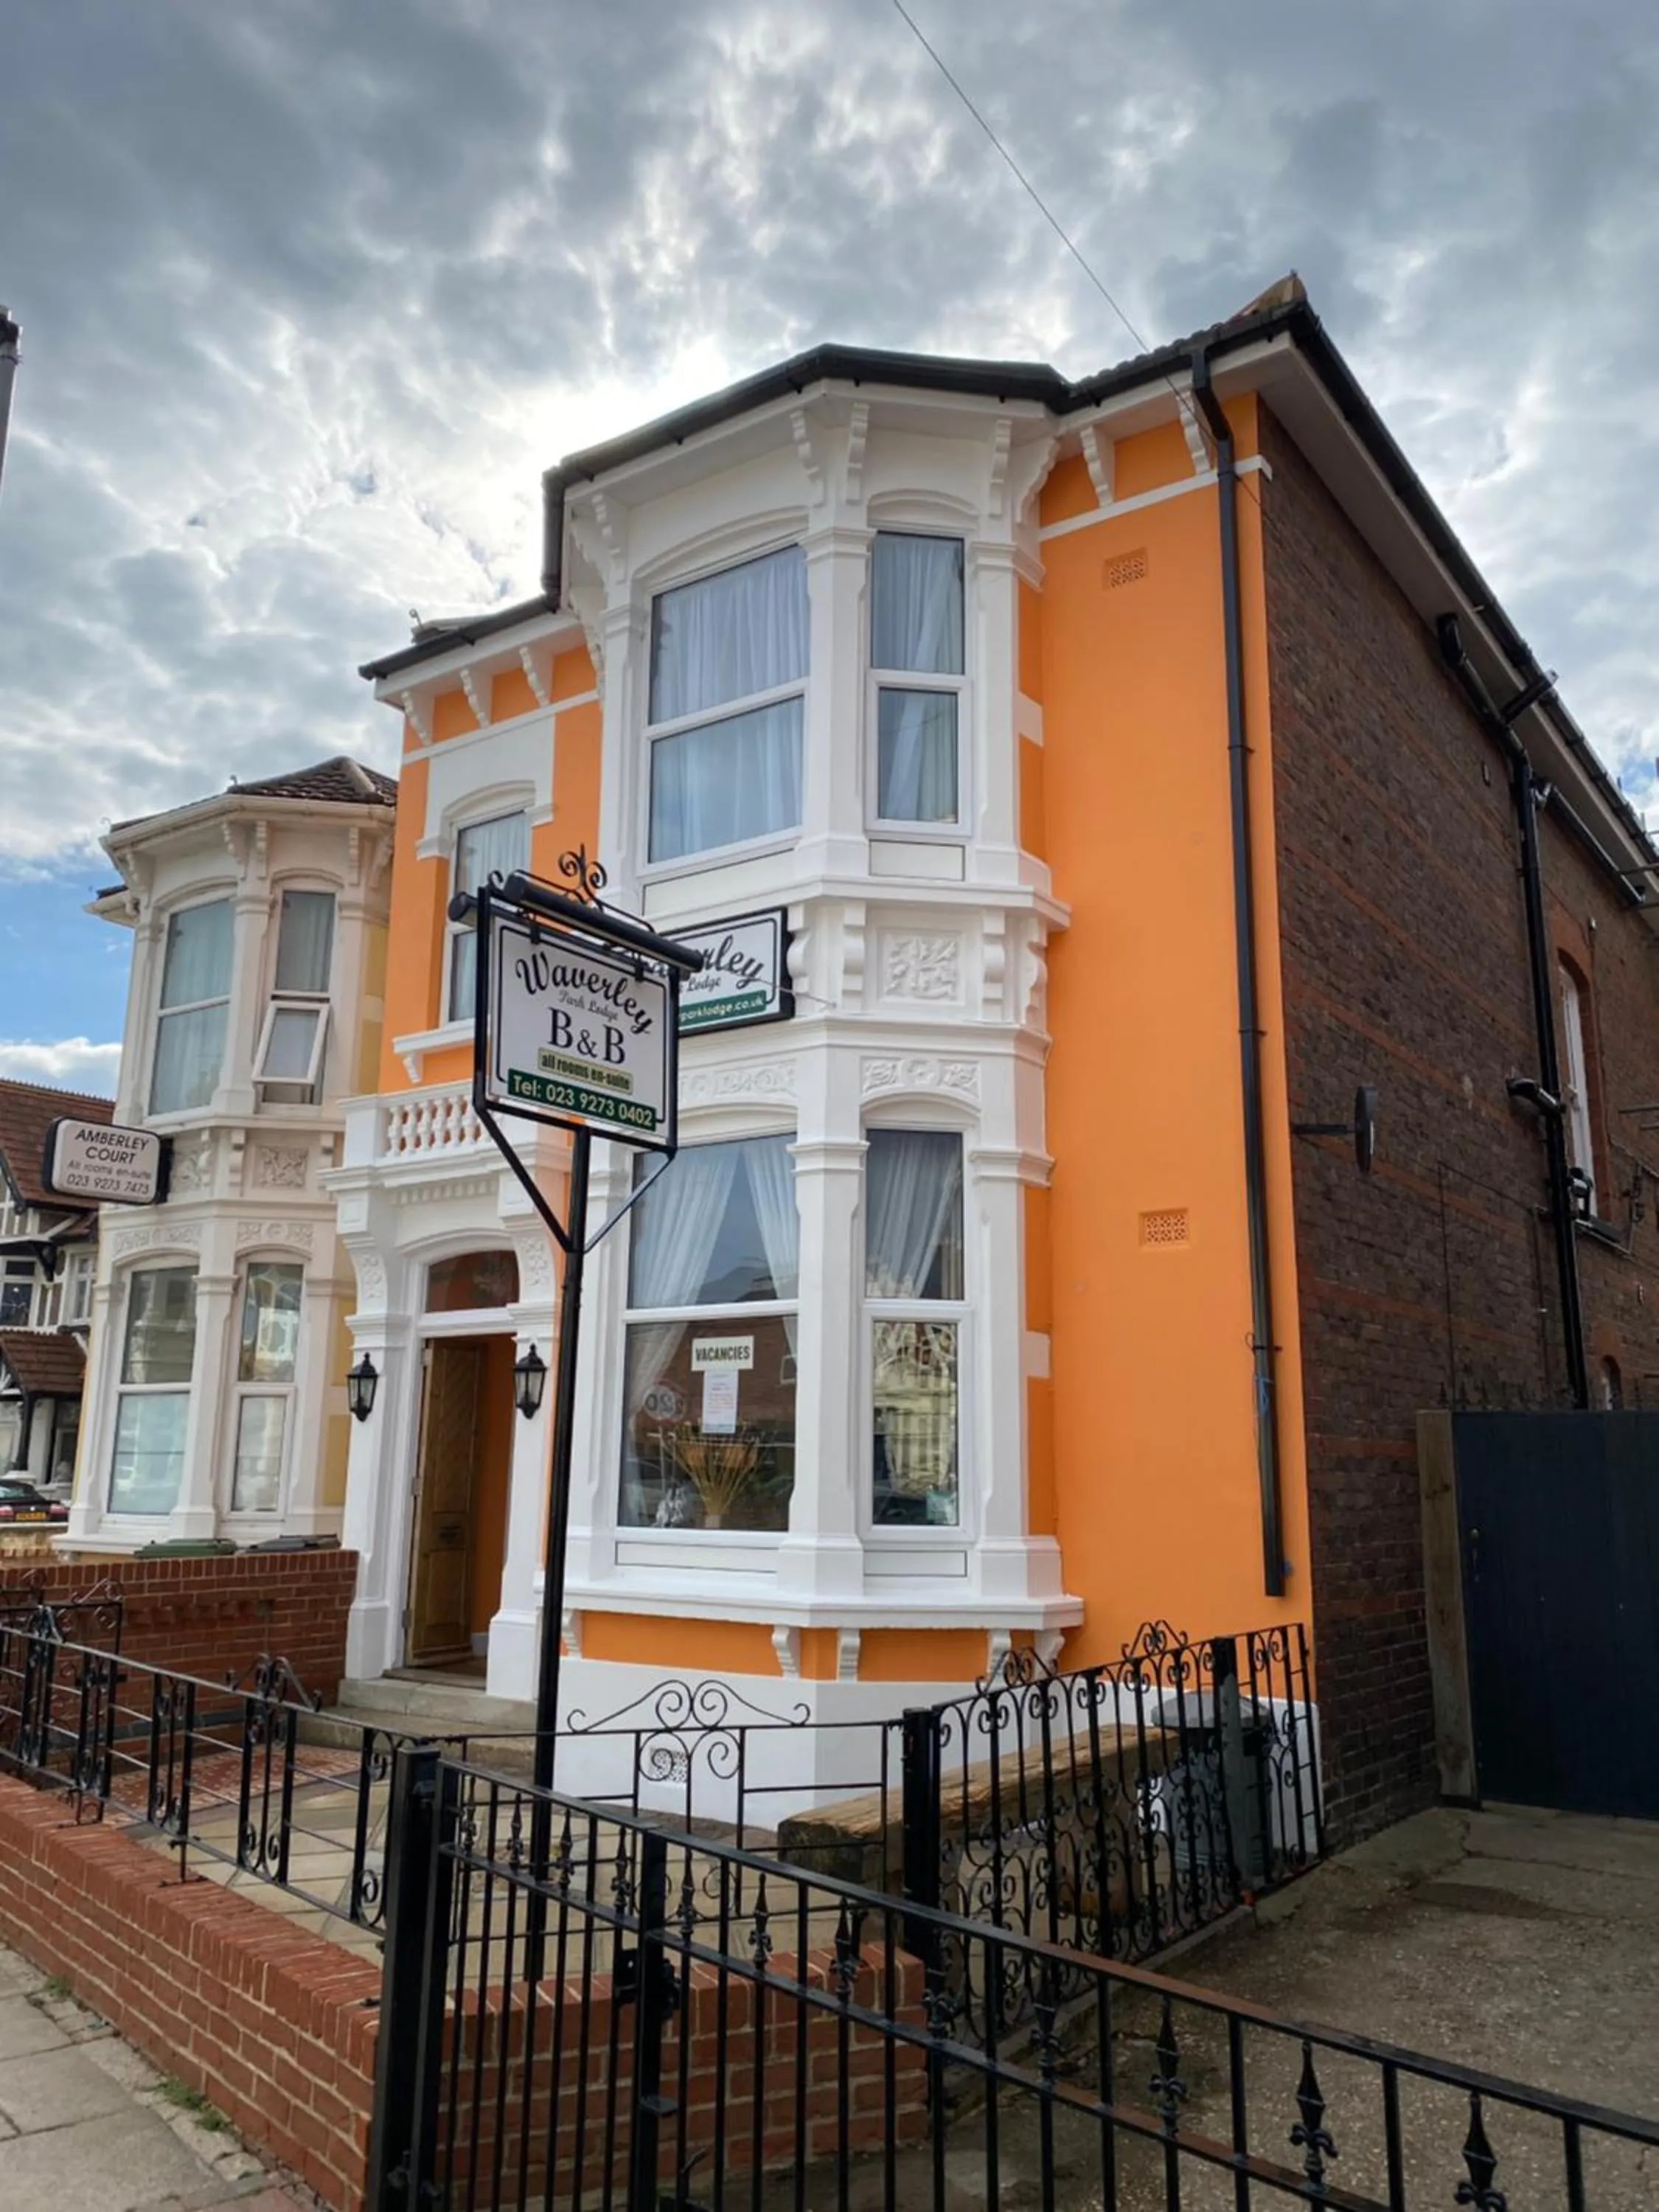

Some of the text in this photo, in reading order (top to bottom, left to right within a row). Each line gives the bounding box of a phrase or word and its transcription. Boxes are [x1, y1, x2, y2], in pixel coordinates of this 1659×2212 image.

[515, 950, 653, 1034] Waverley
[687, 975, 722, 992] Lodge
[558, 990, 619, 1022] Park Lodge
[680, 996, 765, 1023] parklodge.co.uk
[547, 1006, 625, 1064] B&B
[541, 1054, 630, 1090] all rooms en-suite
[512, 1074, 653, 1127] Tel: 023 9273 0402
[74, 1129, 149, 1151] AMBERLEY
[86, 1147, 136, 1164] COURT
[83, 1163, 112, 1176] rooms
[67, 1174, 89, 1187] 023
[94, 1178, 121, 1192] 9273
[695, 1345, 751, 1363] VACANCIES
